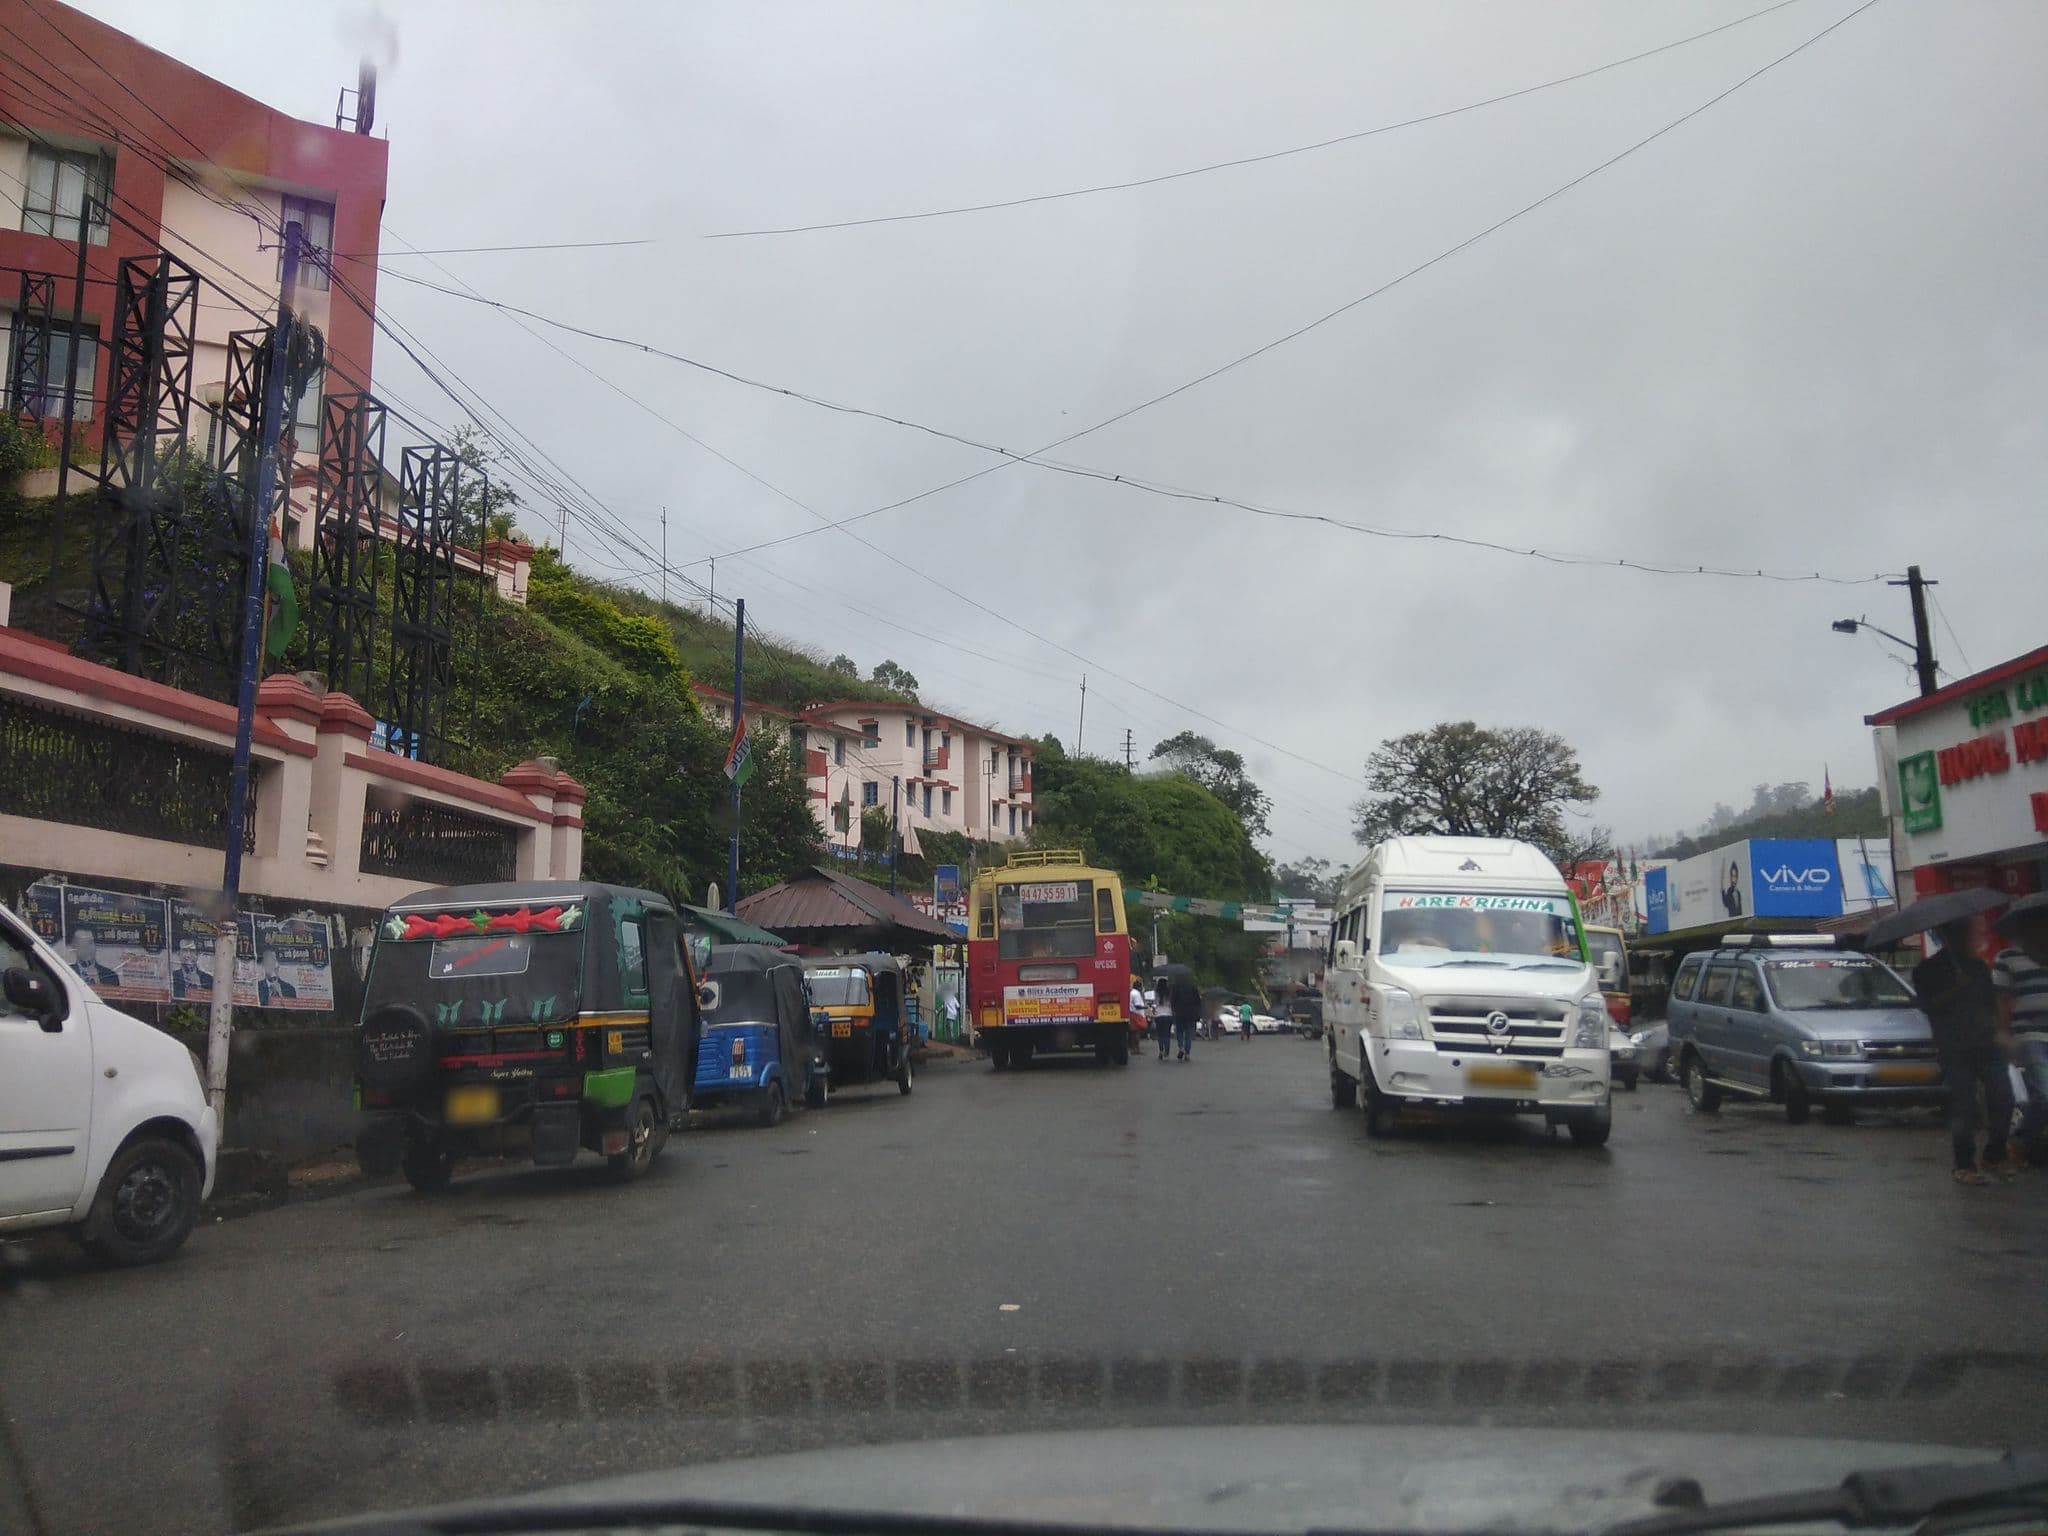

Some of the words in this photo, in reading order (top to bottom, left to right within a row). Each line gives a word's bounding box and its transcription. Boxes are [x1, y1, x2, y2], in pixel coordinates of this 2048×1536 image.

[1760, 864, 1831, 883] vivo
[1021, 889, 1030, 900] 94
[1032, 888, 1041, 899] 47
[1044, 888, 1053, 899] 55
[1056, 888, 1065, 899] 59
[1068, 887, 1077, 898] 11
[145, 929, 158, 945] 17
[313, 948, 324, 960] 17
[1046, 986, 1079, 995] Academy
